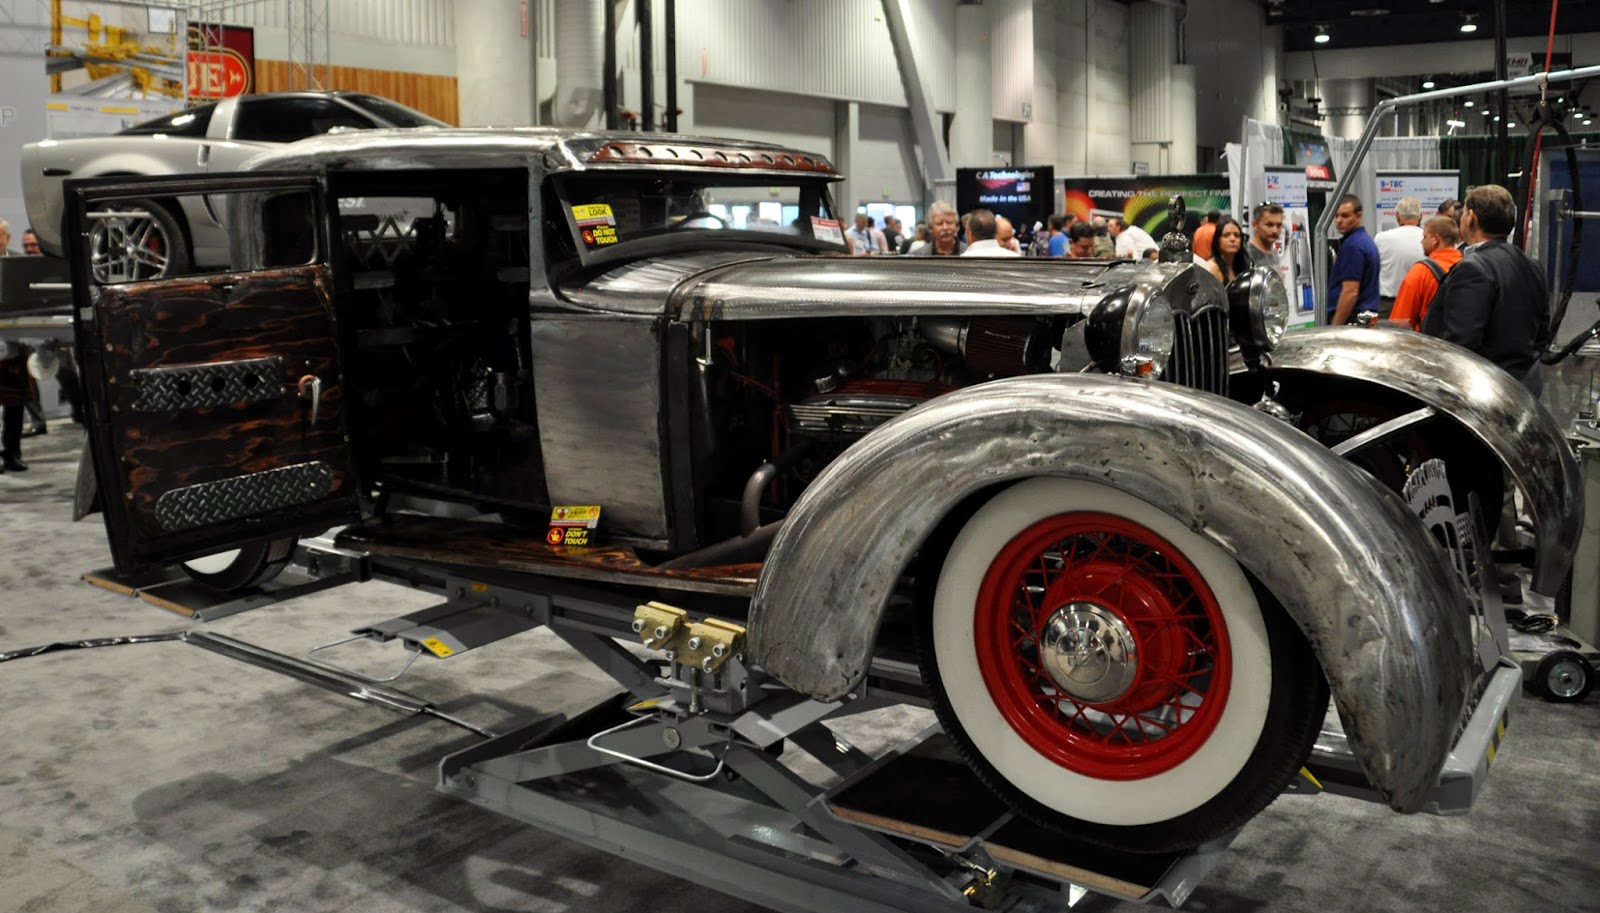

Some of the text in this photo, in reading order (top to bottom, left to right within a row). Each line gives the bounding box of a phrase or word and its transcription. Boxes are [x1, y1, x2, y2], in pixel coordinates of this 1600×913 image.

[1088, 189, 1135, 198] CREATING
[1137, 189, 1159, 198] THE
[1160, 189, 1208, 198] PERFECT
[979, 194, 1032, 202] Made in the USA
[592, 228, 615, 237] DO NOT
[596, 236, 618, 244] TOUCH
